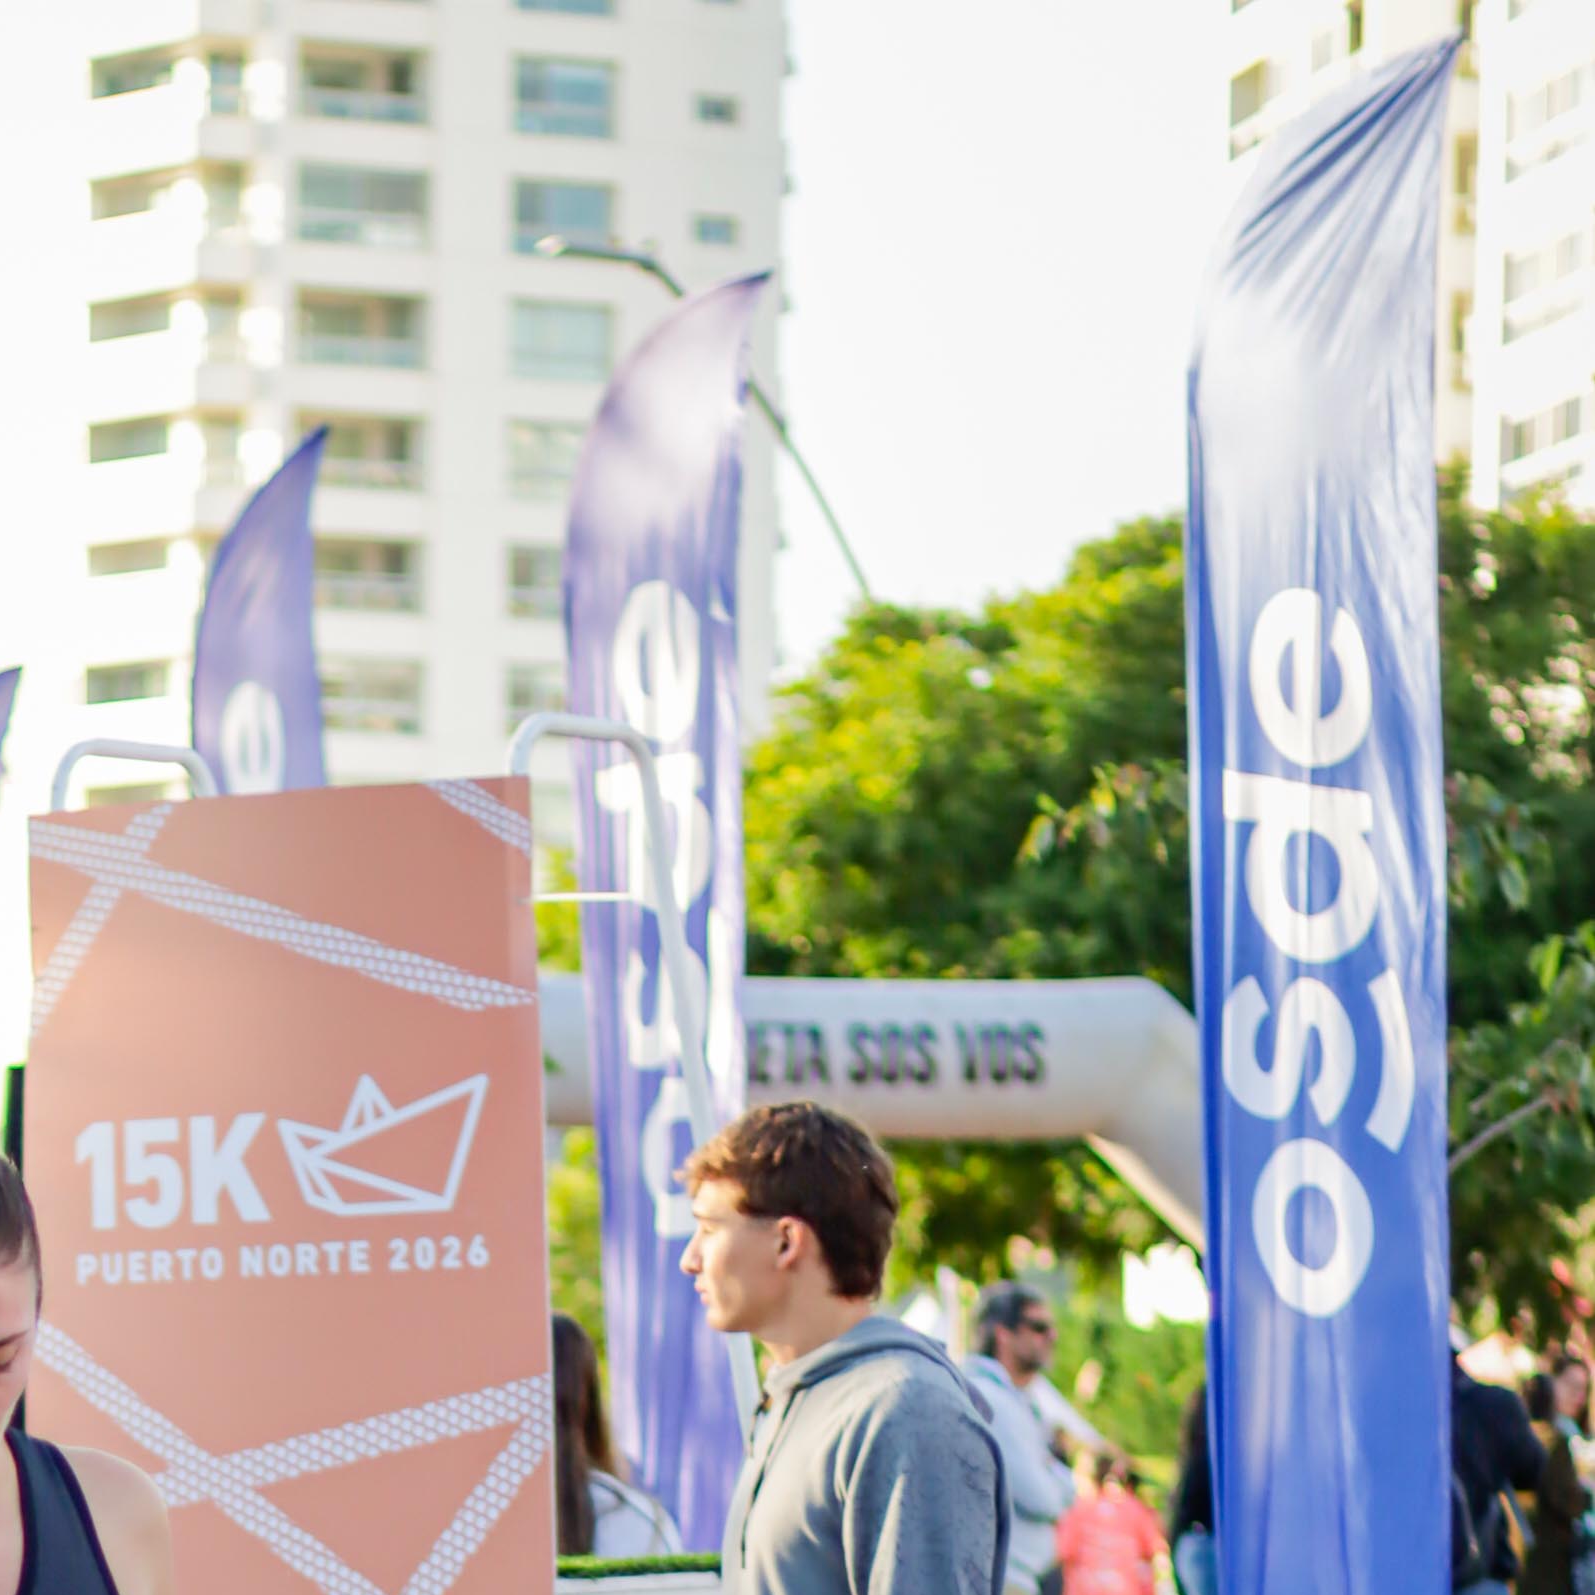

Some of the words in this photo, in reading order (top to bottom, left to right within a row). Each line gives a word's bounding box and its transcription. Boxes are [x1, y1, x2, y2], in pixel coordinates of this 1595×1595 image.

[1220, 587, 1406, 1319] osde
[746, 1020, 831, 1085] ETA
[847, 1020, 938, 1084] SOS
[955, 1020, 1046, 1084] VOS
[74, 1112, 272, 1230] 15K
[75, 1245, 224, 1287] PUERTO
[239, 1239, 371, 1280] NORTE
[389, 1234, 491, 1272] 2026
